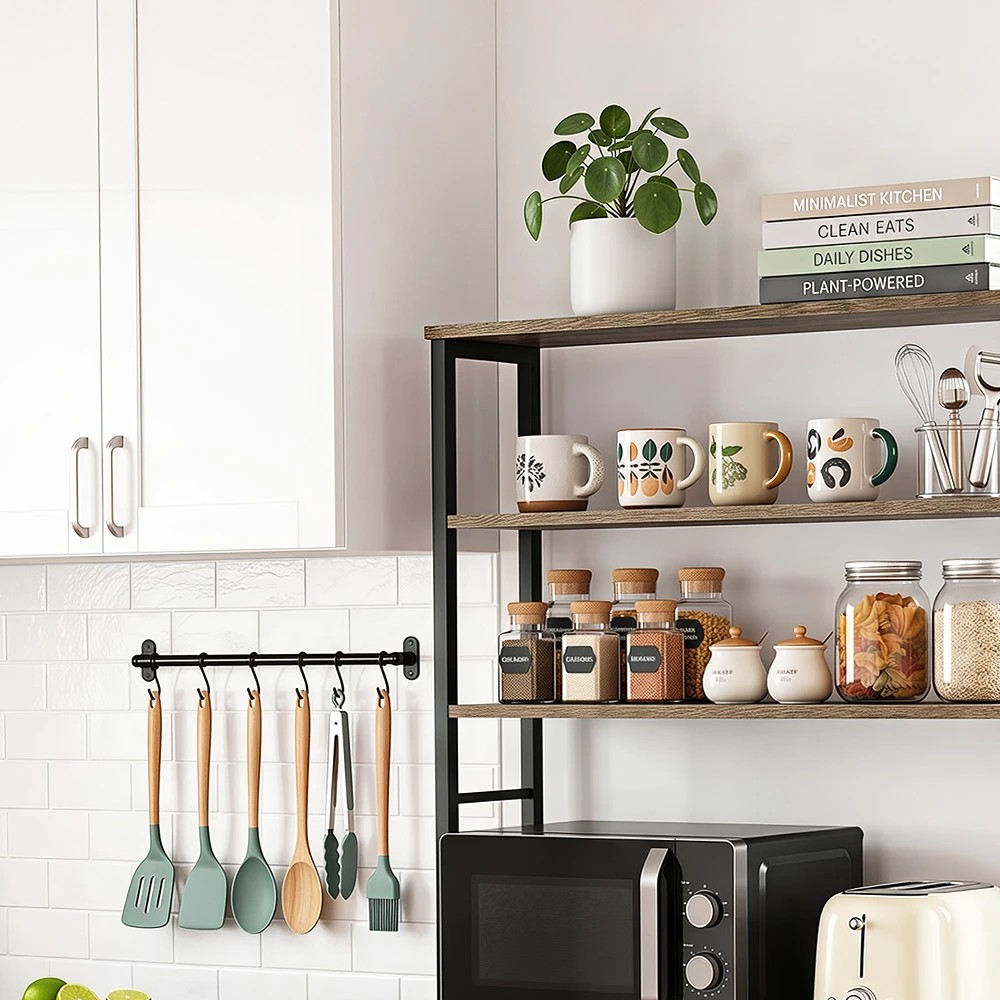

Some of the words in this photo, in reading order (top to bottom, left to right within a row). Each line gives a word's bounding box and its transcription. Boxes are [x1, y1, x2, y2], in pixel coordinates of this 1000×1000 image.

[793, 192, 875, 212] MINIMALIST
[880, 187, 942, 204] KITCHEN
[818, 223, 869, 239] CLEAN
[876, 218, 915, 234] EATS
[813, 252, 853, 267] DAILY
[859, 246, 913, 262] DISHES
[803, 275, 925, 295] PLANT-POWERED
